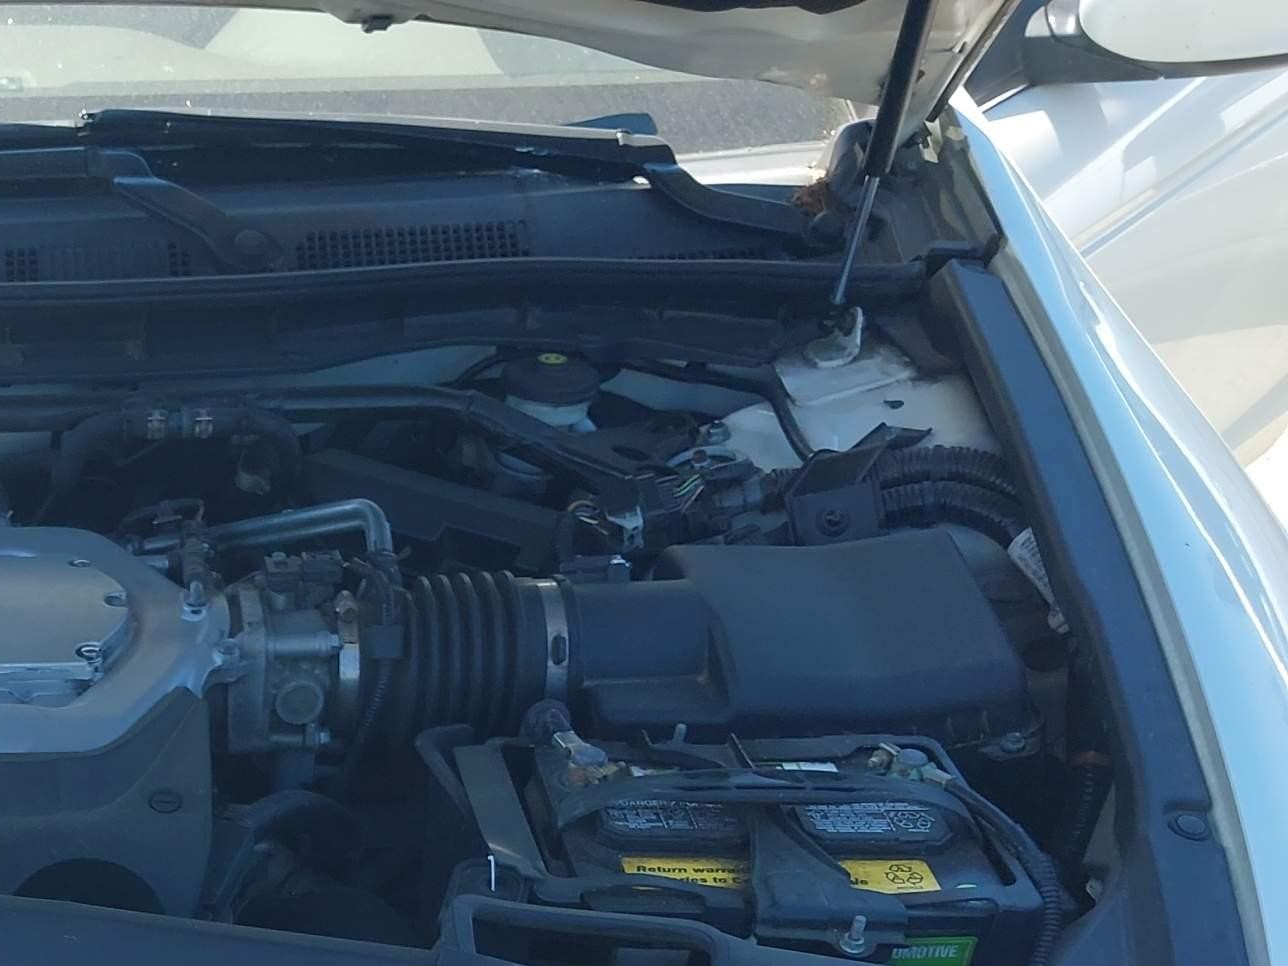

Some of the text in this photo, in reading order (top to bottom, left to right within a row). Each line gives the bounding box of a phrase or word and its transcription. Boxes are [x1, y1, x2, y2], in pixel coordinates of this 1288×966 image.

[636, 865, 748, 874] Return warran
[892, 943, 959, 960] OMOTIVE
